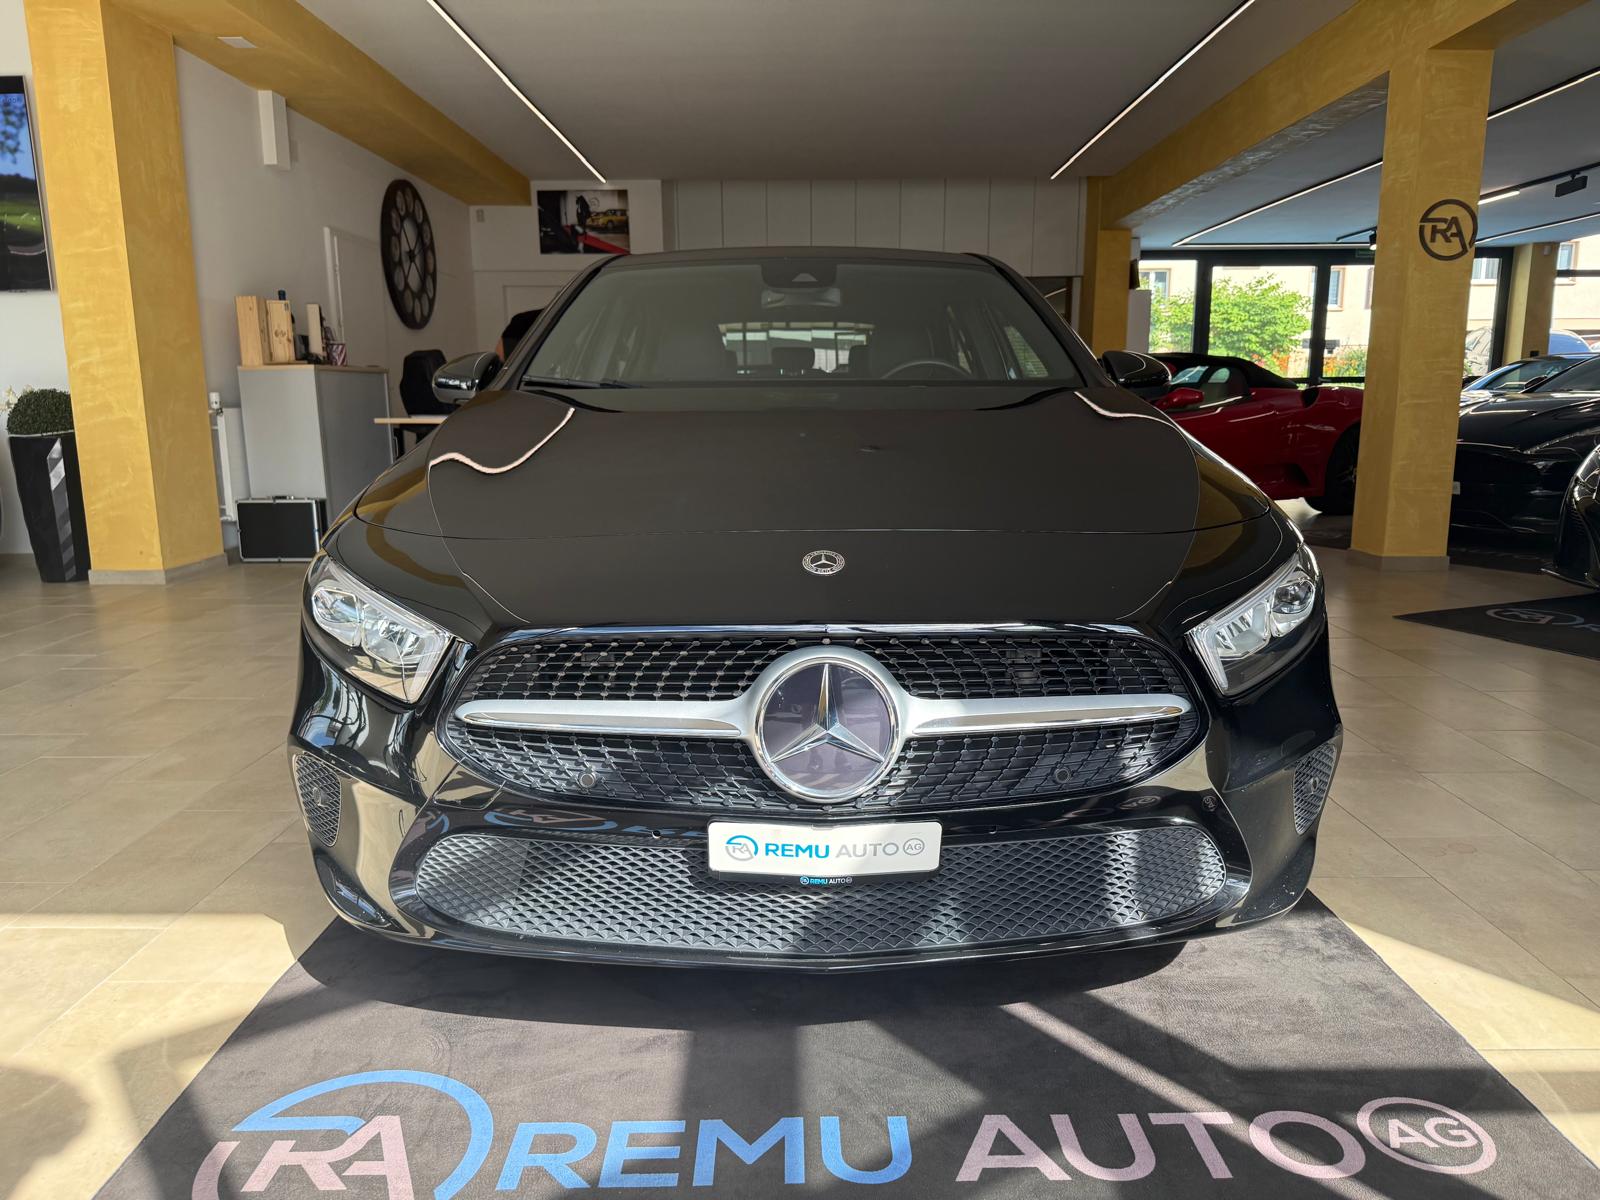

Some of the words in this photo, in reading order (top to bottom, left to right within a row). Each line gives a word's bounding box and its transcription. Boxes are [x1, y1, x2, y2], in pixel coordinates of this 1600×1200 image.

[1420, 215, 1469, 253] RA
[765, 843, 830, 859] REMU
[835, 842, 899, 858] AUTO
[495, 1115, 912, 1191] REMU
[955, 1110, 1366, 1182] AUTO
[1387, 1116, 1480, 1149] AG
